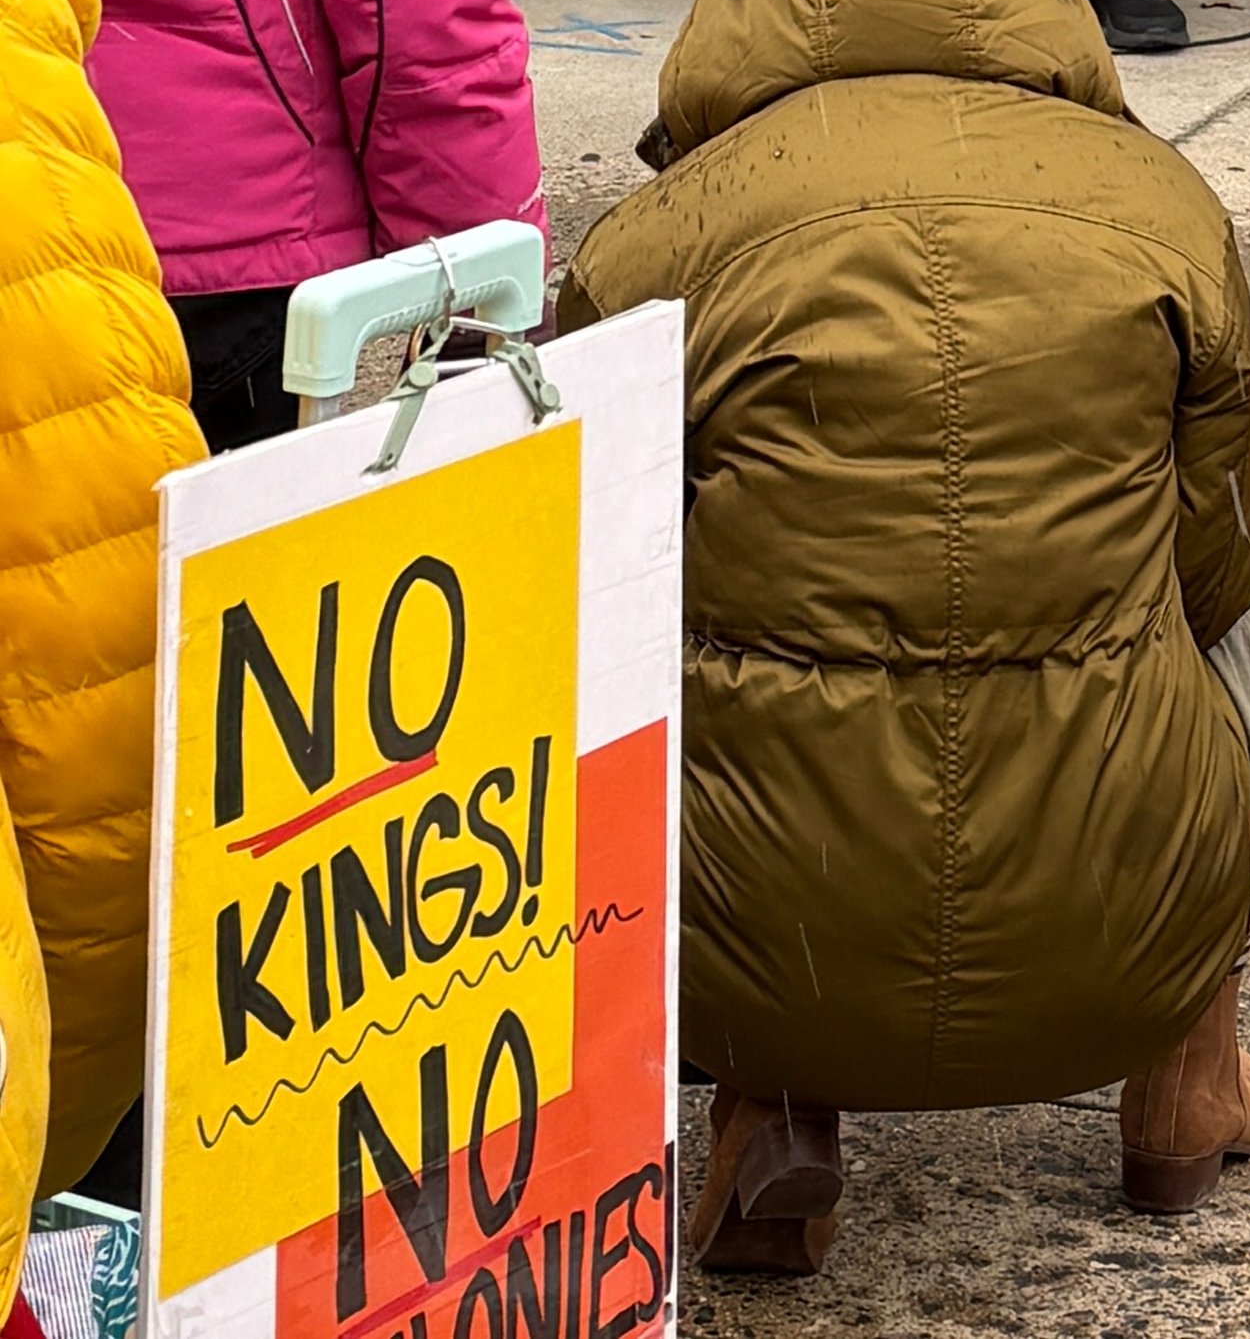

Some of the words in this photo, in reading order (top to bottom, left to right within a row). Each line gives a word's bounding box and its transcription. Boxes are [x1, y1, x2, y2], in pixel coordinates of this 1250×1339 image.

[213, 554, 466, 829] NO
[215, 734, 554, 1066] KINGS!
[336, 1008, 540, 1322] NO
